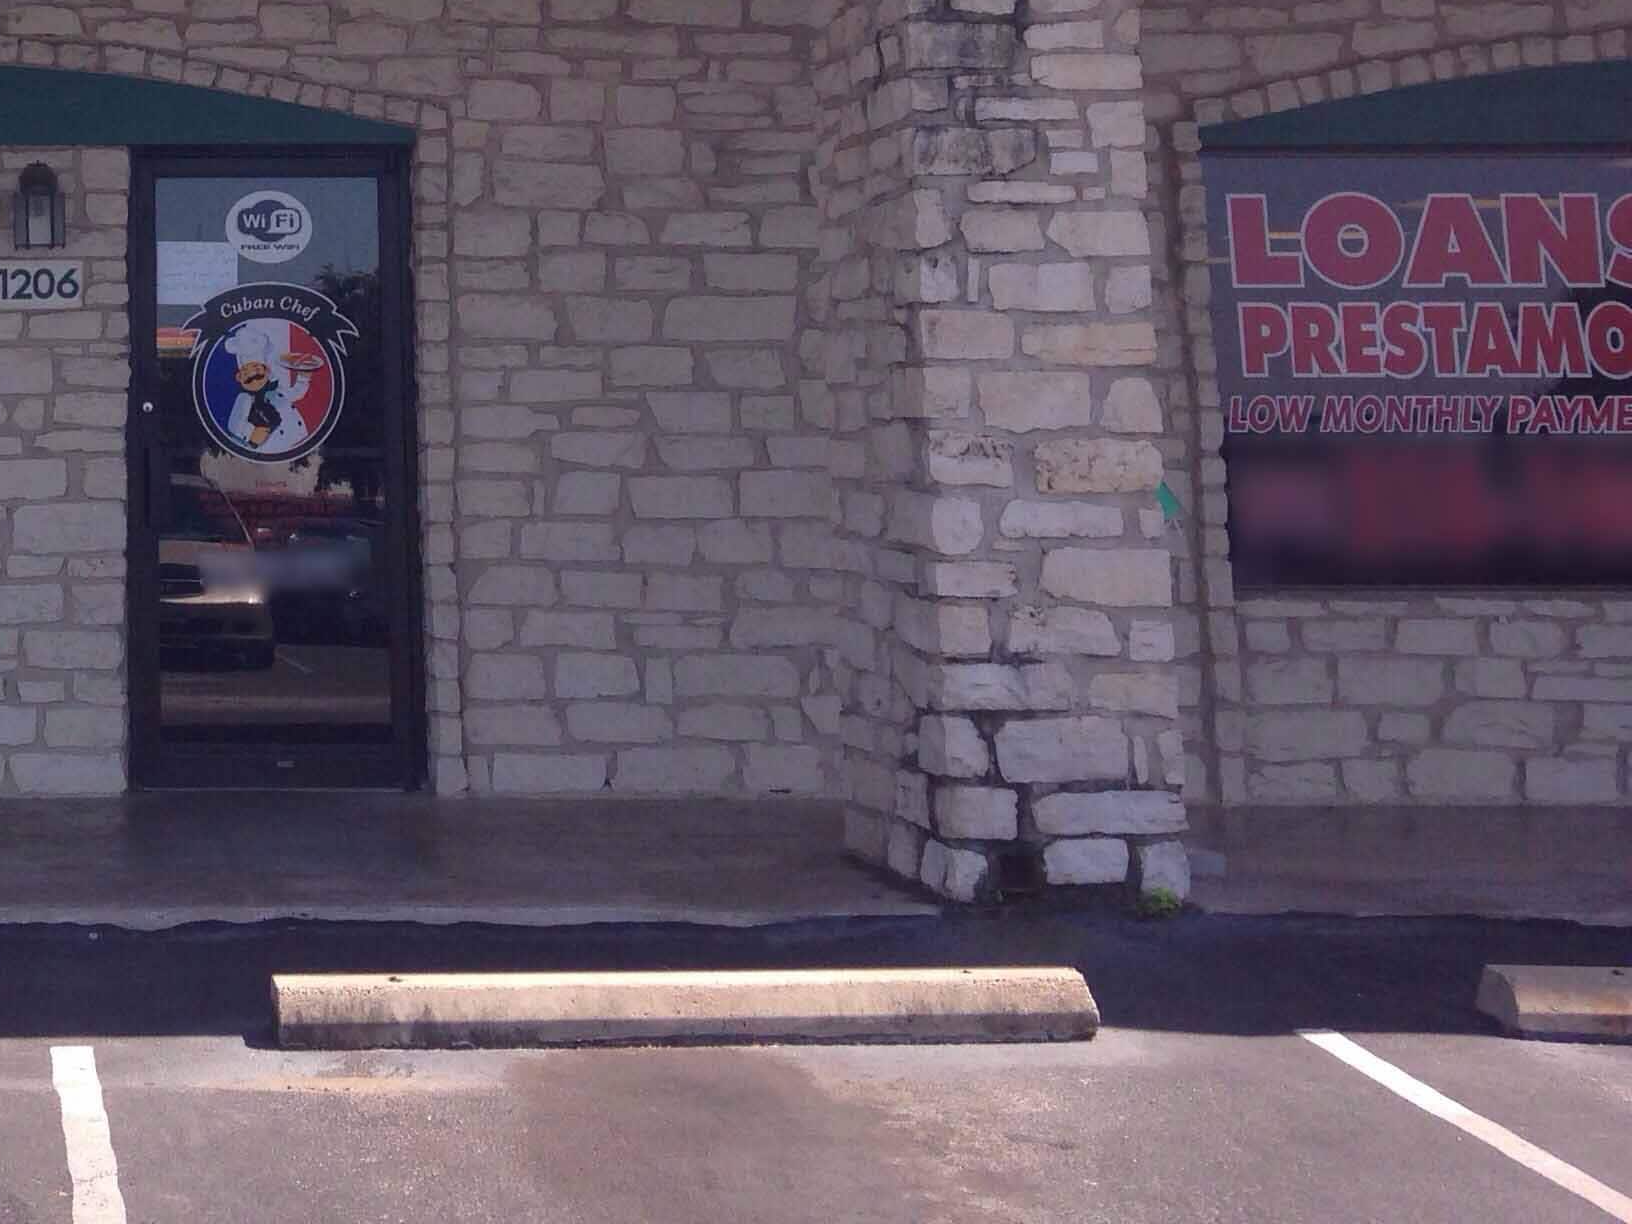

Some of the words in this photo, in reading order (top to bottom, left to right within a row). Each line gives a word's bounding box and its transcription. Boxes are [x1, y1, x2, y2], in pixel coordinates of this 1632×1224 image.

[220, 297, 275, 319] Cuban
[279, 296, 320, 323] Chef
[1229, 395, 1314, 433] LOW
[1319, 395, 1500, 433] MONTHLY
